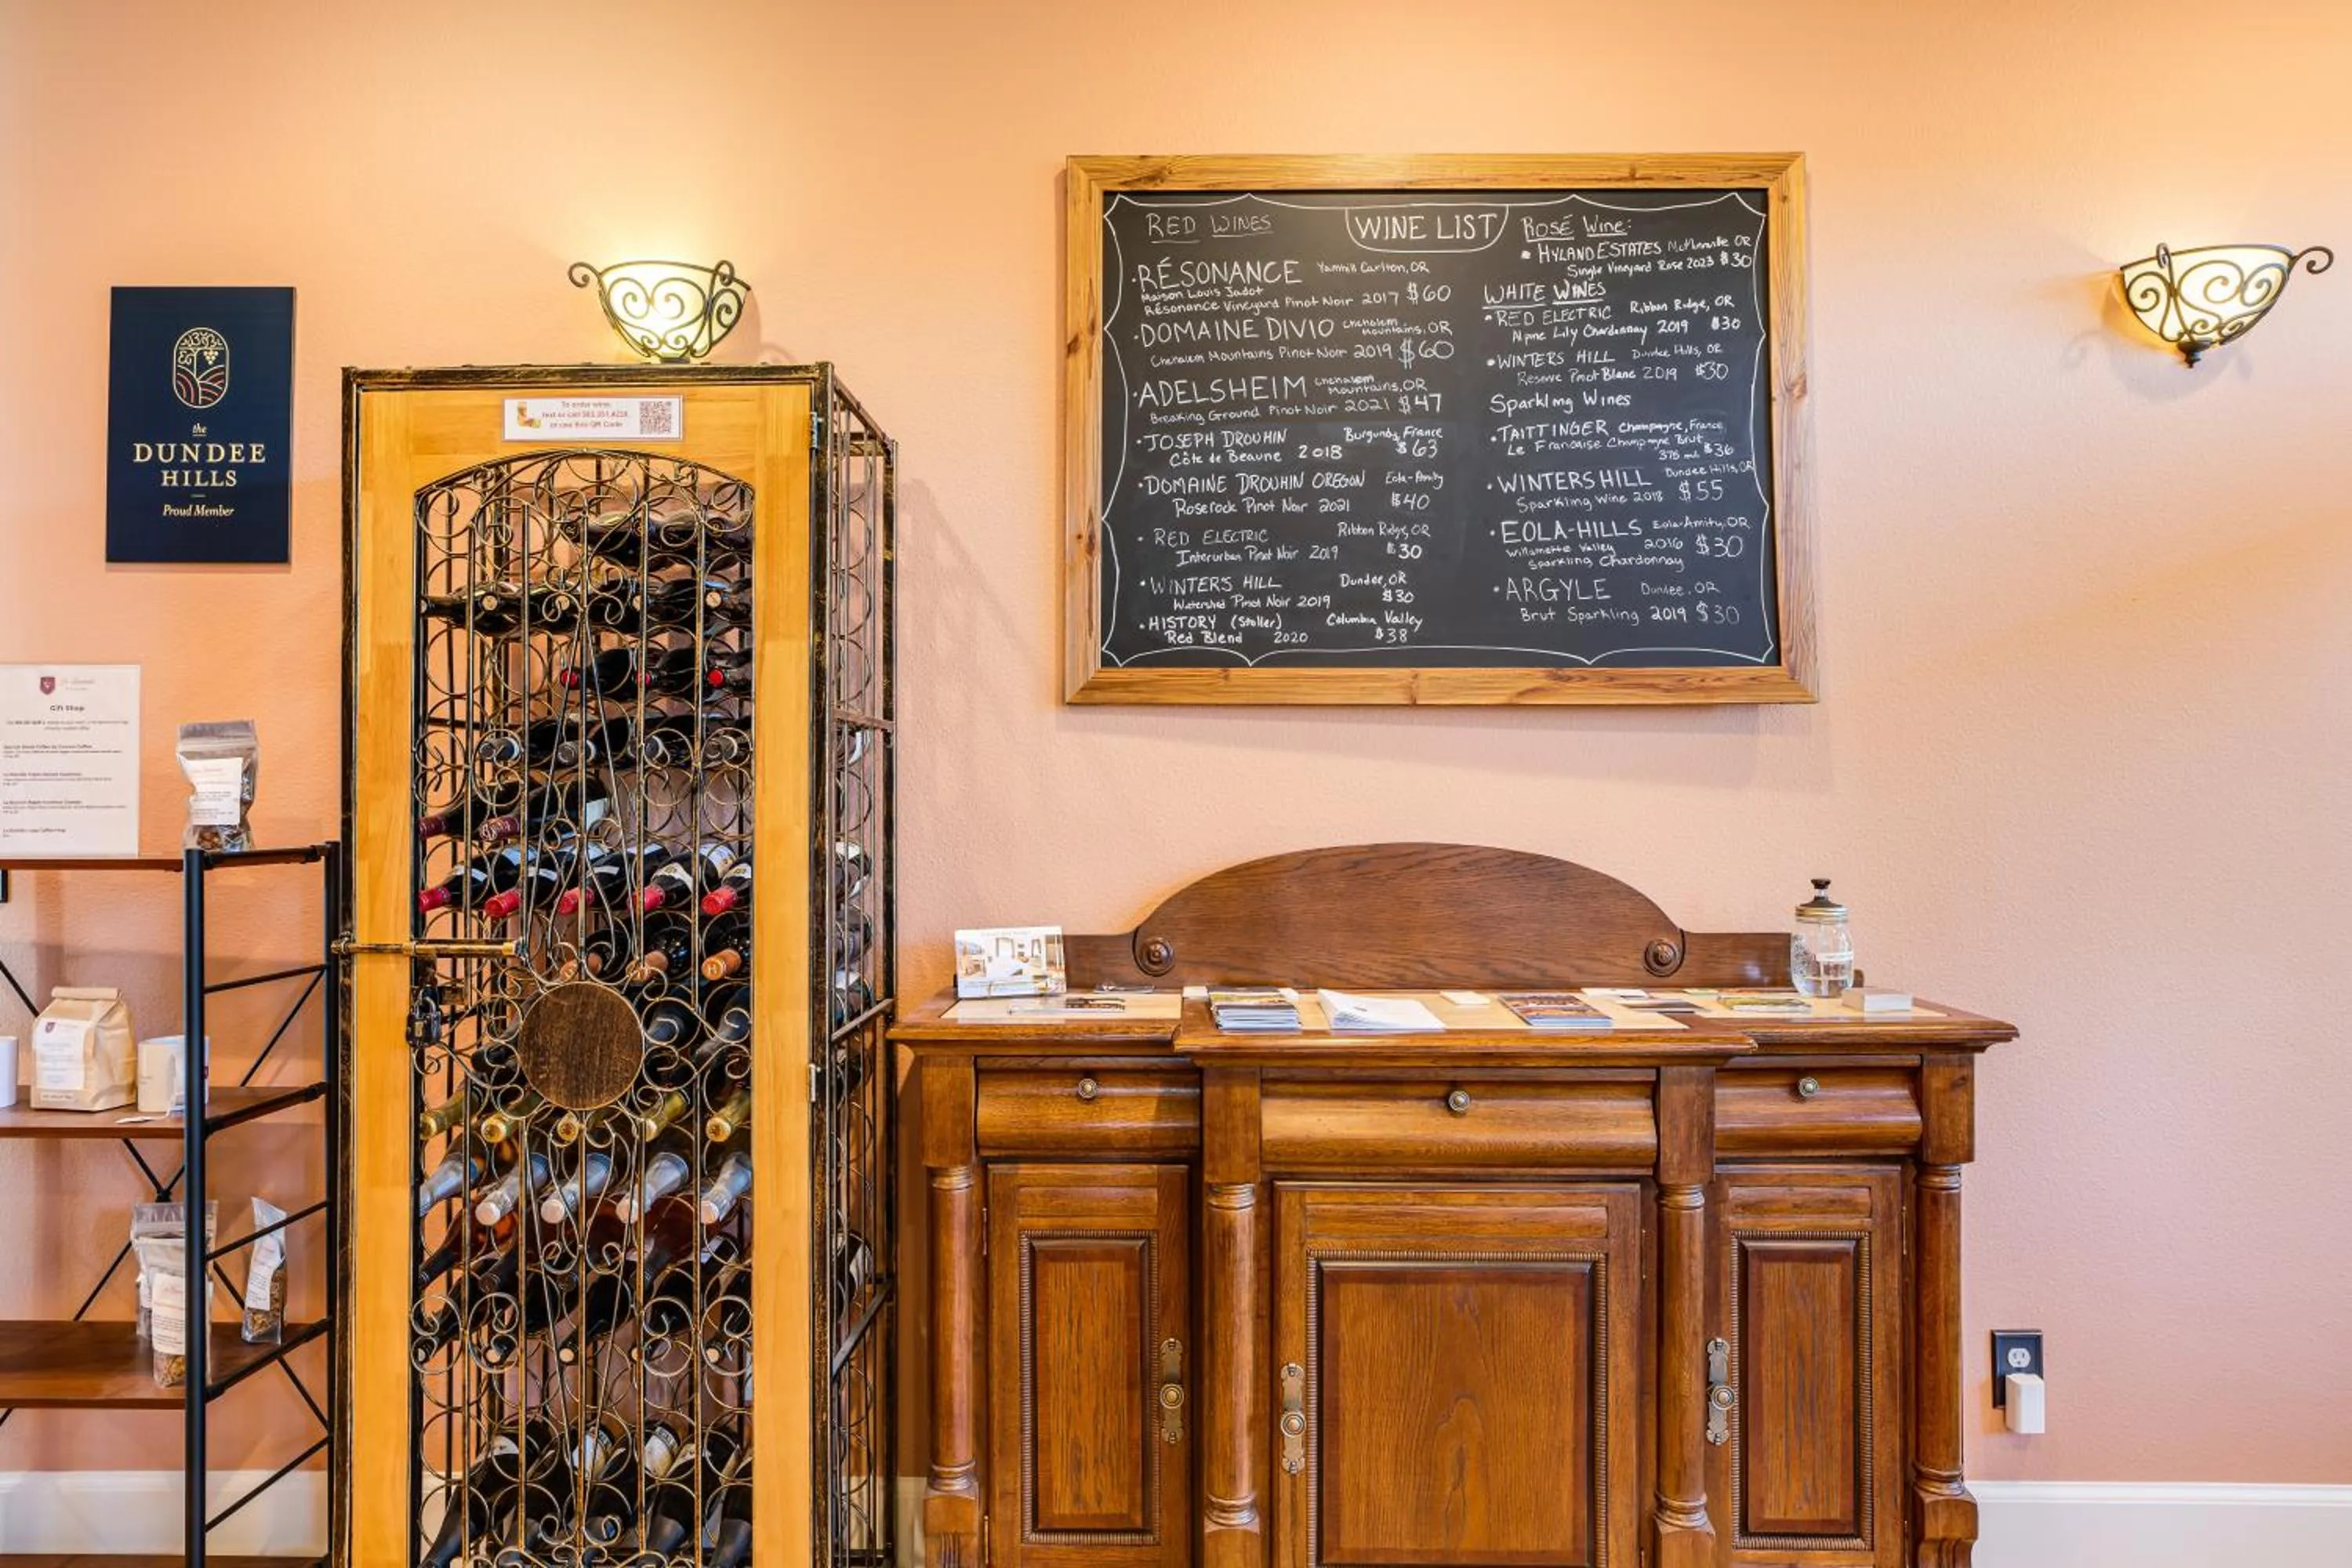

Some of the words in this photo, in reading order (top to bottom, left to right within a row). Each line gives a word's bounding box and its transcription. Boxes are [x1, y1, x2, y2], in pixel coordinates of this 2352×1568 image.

[1146, 213, 1196, 237] RED
[1210, 215, 1271, 233] WINES
[1355, 216, 1427, 239] WINE
[1437, 213, 1497, 239] LIST
[1597, 241, 1662, 260] ESTATES
[1686, 256, 1715, 269] 2023
[1719, 250, 1752, 267] $30
[1138, 256, 1302, 292] RÉSONANCE
[1323, 296, 1353, 307] Noir
[1362, 292, 1399, 306] 2017
[1407, 282, 1451, 305] $60
[1484, 282, 1546, 304] WHITE
[1552, 278, 1606, 300] WINES
[1496, 310, 1534, 327] RED
[1542, 306, 1611, 325] ELECTRIC
[1715, 295, 1735, 307] OR
[1141, 319, 1260, 347] DOMAINE
[1265, 316, 1334, 341] DIVIO
[1428, 321, 1452, 336] OR
[1657, 319, 1688, 334] 2019
[1711, 316, 1741, 330] $30
[1354, 343, 1392, 359] 2019
[1399, 337, 1454, 369] $60
[1497, 352, 1565, 369] WINTERS
[1577, 349, 1616, 364] HILL
[1642, 366, 1678, 381] 2019
[1138, 376, 1308, 408] ADELSHEIM
[1403, 378, 1428, 391] OR
[1345, 398, 1391, 412] 2021
[1399, 394, 1441, 414] $47
[1583, 388, 1632, 407] Wines
[193, 423, 207, 434] the
[1497, 419, 1609, 443] TAITTINGER
[1144, 431, 1214, 452] JOSEPH
[1221, 428, 1288, 448] DROUHIN
[1508, 444, 1526, 456] Le
[132, 443, 266, 463] DUNDEE
[1170, 451, 1203, 467] Côte
[1208, 452, 1221, 463] de
[1226, 449, 1282, 463] Beaune
[1395, 439, 1439, 459] $63
[161, 470, 237, 487] HILLS
[1143, 474, 1228, 495] DOMAINE
[1236, 470, 1305, 495] DROUHIN
[1312, 470, 1367, 489] OREGON
[1497, 471, 1595, 493] WINTERS
[1599, 468, 1653, 489] HILL
[1633, 491, 1663, 503] 2018
[1679, 480, 1723, 502] $55
[162, 504, 192, 517] Proud
[194, 504, 234, 517] Member
[1319, 498, 1349, 513] 2021
[1392, 492, 1431, 510] $40
[1154, 528, 1190, 547] RED
[1203, 529, 1269, 545] ELECTRIC
[1501, 519, 1642, 543] EOLA-HILLS
[1727, 517, 1751, 529] OR
[1308, 545, 1339, 560] 2019
[1386, 542, 1422, 559] $30
[1644, 537, 1683, 550] 2016
[1696, 534, 1744, 557] $30
[1150, 576, 1233, 594] WINTERS
[1243, 575, 1283, 590] HILL
[1506, 577, 1611, 602] ARGYLE
[1694, 581, 1722, 593] OR
[1265, 593, 1291, 608] Noir
[1296, 595, 1330, 609] 2019
[1382, 590, 1414, 603] $30
[1149, 613, 1216, 630] HISTORY
[1520, 607, 1556, 621] Brut
[1650, 605, 1687, 622] 2019
[1697, 601, 1740, 624] $30
[1164, 630, 1193, 644] Red
[1200, 630, 1243, 644] Blend
[1274, 631, 1308, 644] 2020
[1374, 626, 1408, 643] $38
